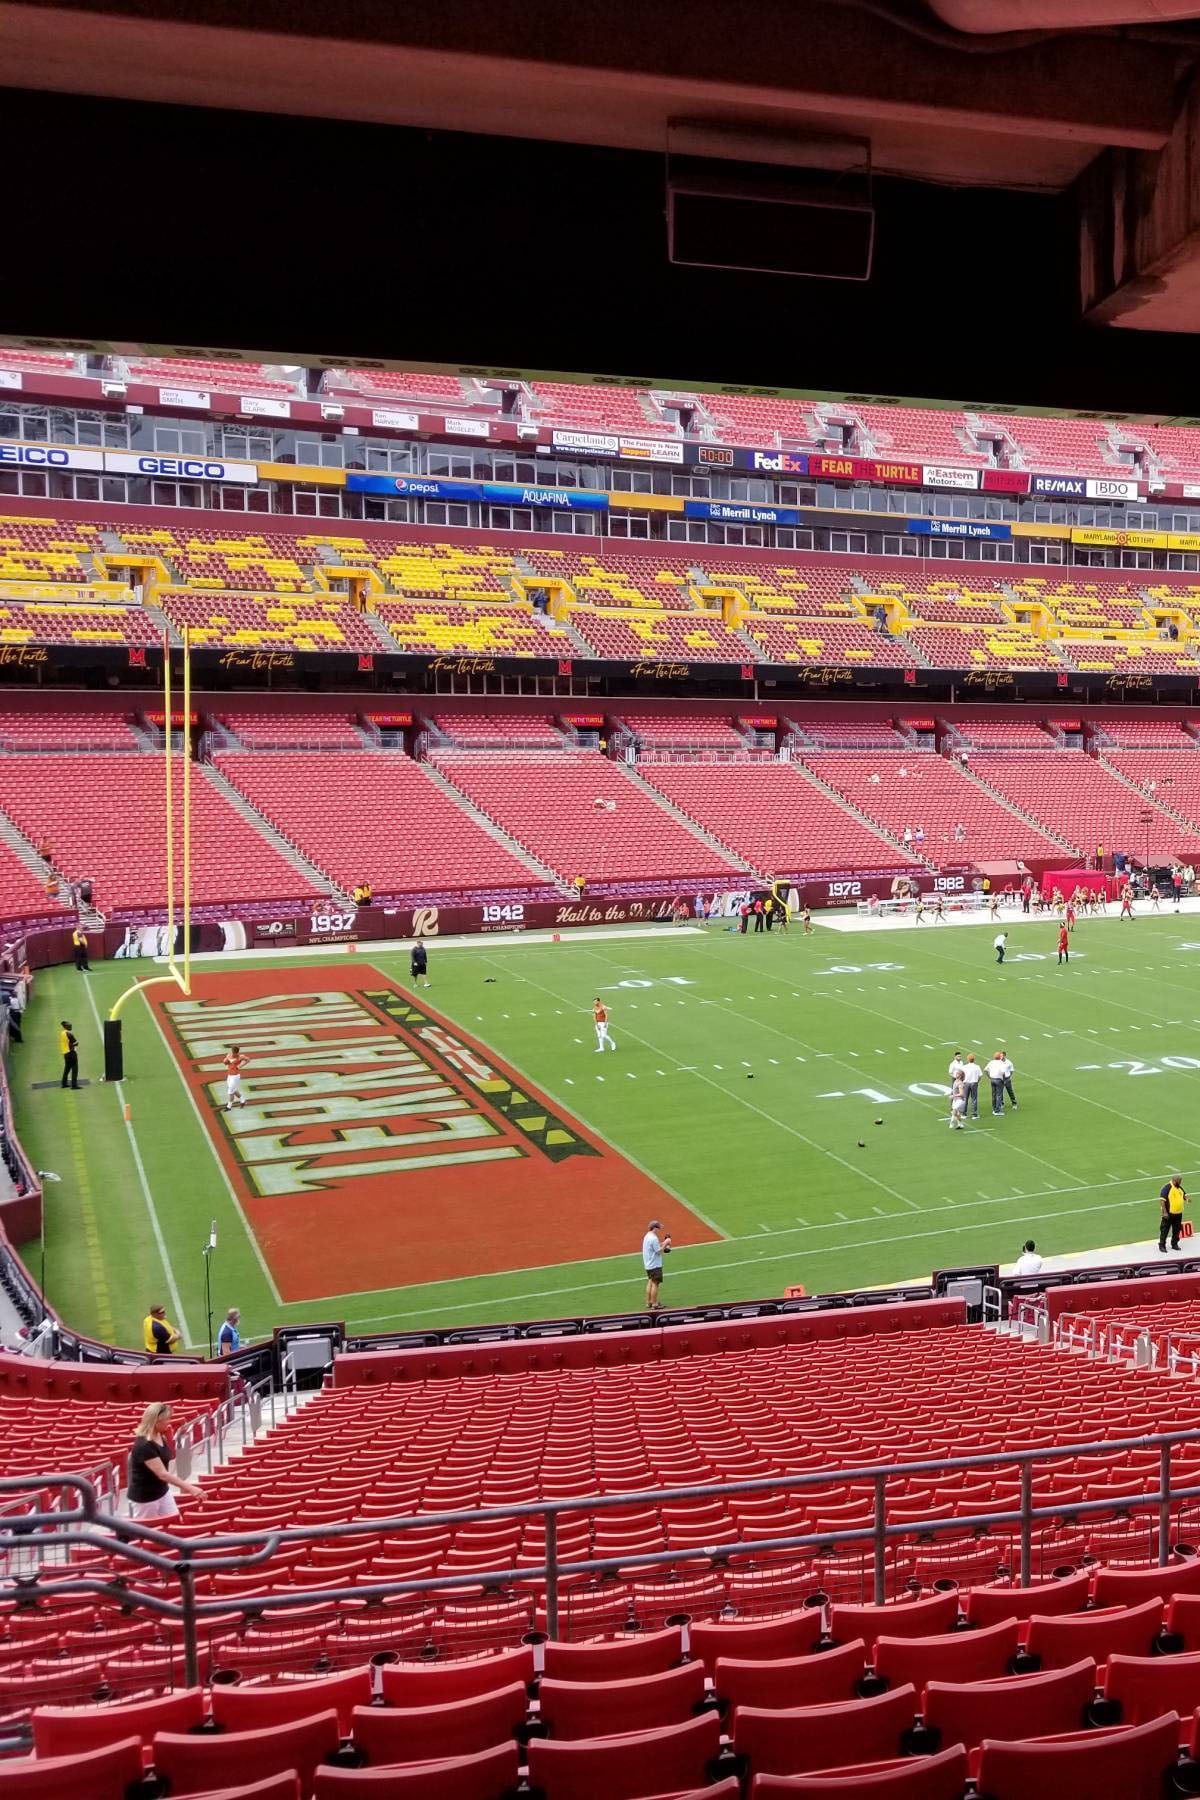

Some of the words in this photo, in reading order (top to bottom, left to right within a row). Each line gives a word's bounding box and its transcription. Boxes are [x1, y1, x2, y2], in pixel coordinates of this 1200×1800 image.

[161, 390, 179, 399] Jerry
[161, 396, 183, 405] SMITH
[243, 405, 266, 413] CLARK
[374, 418, 400, 426] HARVEY
[556, 432, 606, 446] Carpetland
[636, 440, 656, 448] Future
[555, 445, 616, 456] www.mycarpetland.com
[622, 447, 651, 457] Support
[652, 449, 680, 457] LEARN
[138, 457, 225, 479] GEICO
[754, 452, 801, 471] FedEx
[935, 469, 974, 480] Eastern
[410, 482, 440, 494] pepsi
[1036, 479, 1082, 494] RE/MAX
[1099, 481, 1128, 496] BDO
[522, 489, 571, 507] AQUAFINA
[722, 507, 750, 519] Merrill
[752, 509, 777, 521] Lynch
[942, 523, 967, 535] Merrill
[968, 525, 991, 537] Lynch
[1083, 533, 1115, 543] MARYLAND
[1129, 535, 1155, 544] LOTTERY
[129, 647, 146, 667] M
[358, 654, 374, 671] M
[558, 659, 573, 676] M
[741, 664, 754, 680] M
[904, 669, 917, 684] M
[1057, 672, 1068, 687] M
[828, 881, 861, 897] 1972
[934, 877, 965, 891] 1982
[482, 904, 524, 922] 1942
[555, 905, 589, 923] Hail
[589, 907, 602, 920] to
[605, 904, 626, 920] the
[311, 914, 356, 933] 1937
[322, 934, 358, 943] CHAMPIONS
[848, 1082, 954, 1104] 10
[1181, 1221, 1193, 1238] 10
